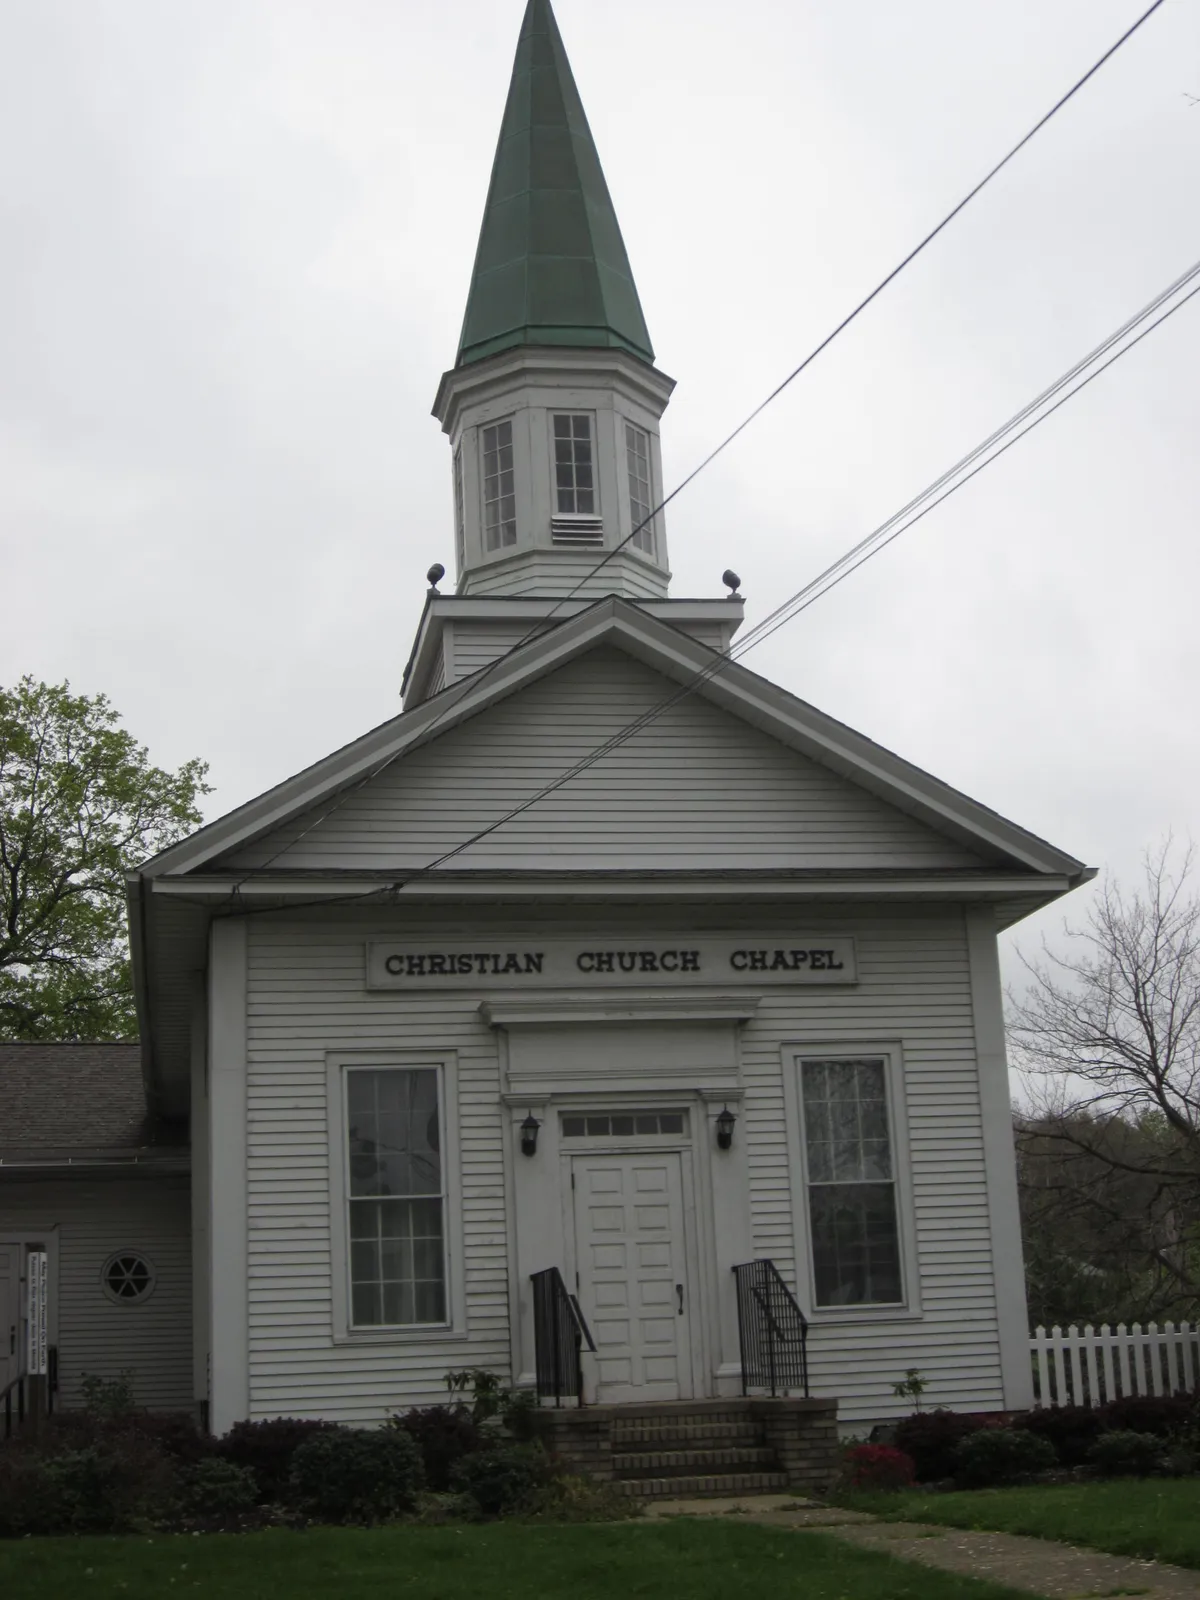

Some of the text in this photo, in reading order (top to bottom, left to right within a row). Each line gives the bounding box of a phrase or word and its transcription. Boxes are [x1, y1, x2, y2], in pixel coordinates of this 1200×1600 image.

[385, 949, 844, 976] CHRISTIAN CHURCH CHAPEL
